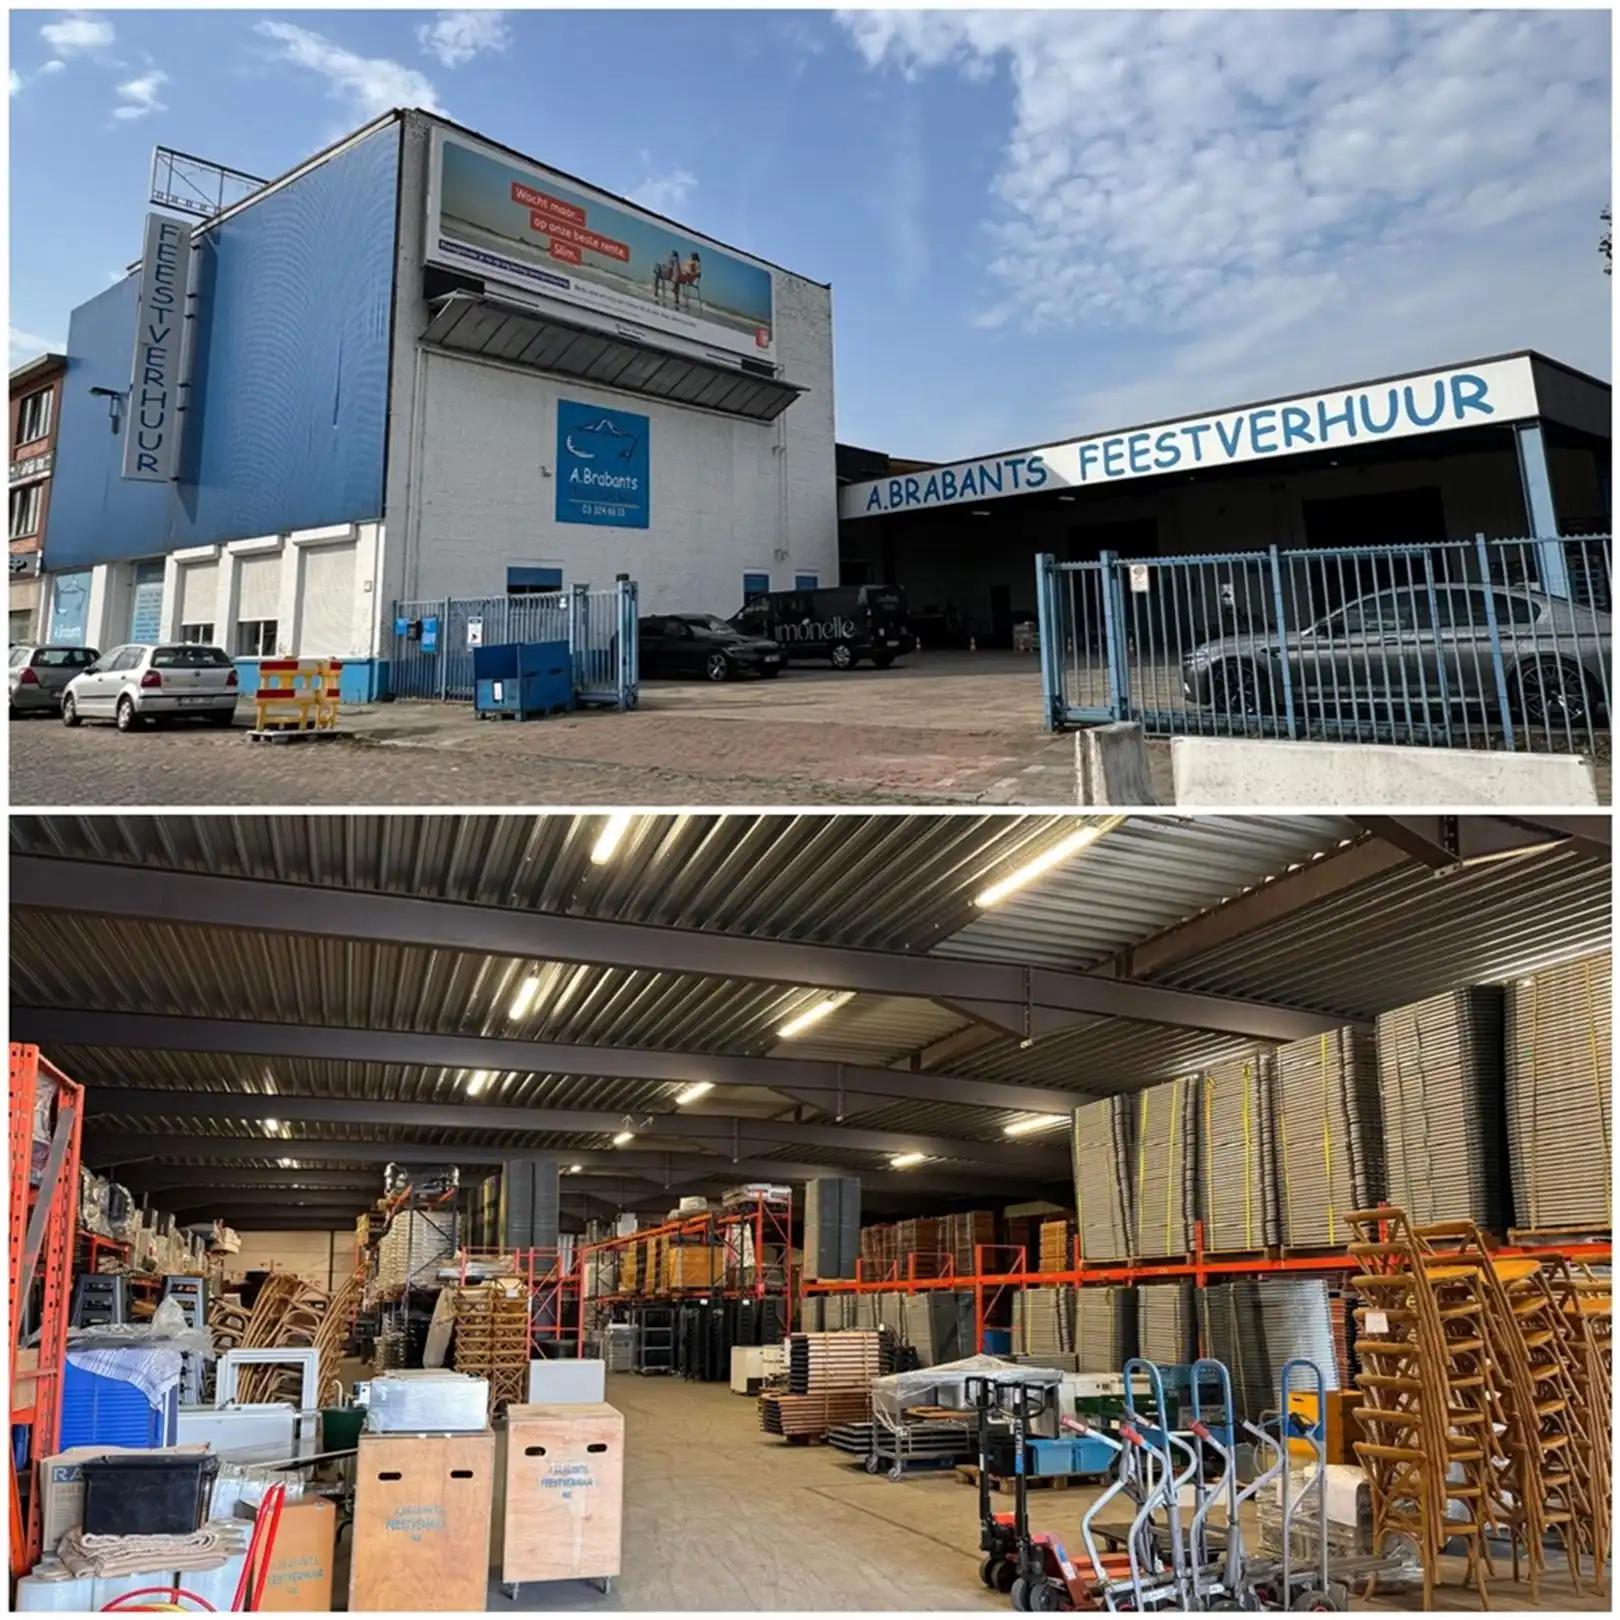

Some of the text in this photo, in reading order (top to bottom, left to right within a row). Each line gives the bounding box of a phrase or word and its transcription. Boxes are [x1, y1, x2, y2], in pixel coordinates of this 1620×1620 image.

[515, 186, 549, 209] Wacht
[533, 217, 549, 231] op
[548, 223, 573, 239] onze
[573, 230, 600, 248] beste
[136, 222, 181, 473] FEESTVERHUUR
[1079, 373, 1496, 481] FEESTVERHUUR
[569, 467, 638, 490] A.Brabants
[866, 455, 1048, 512] A.BRABANTS
